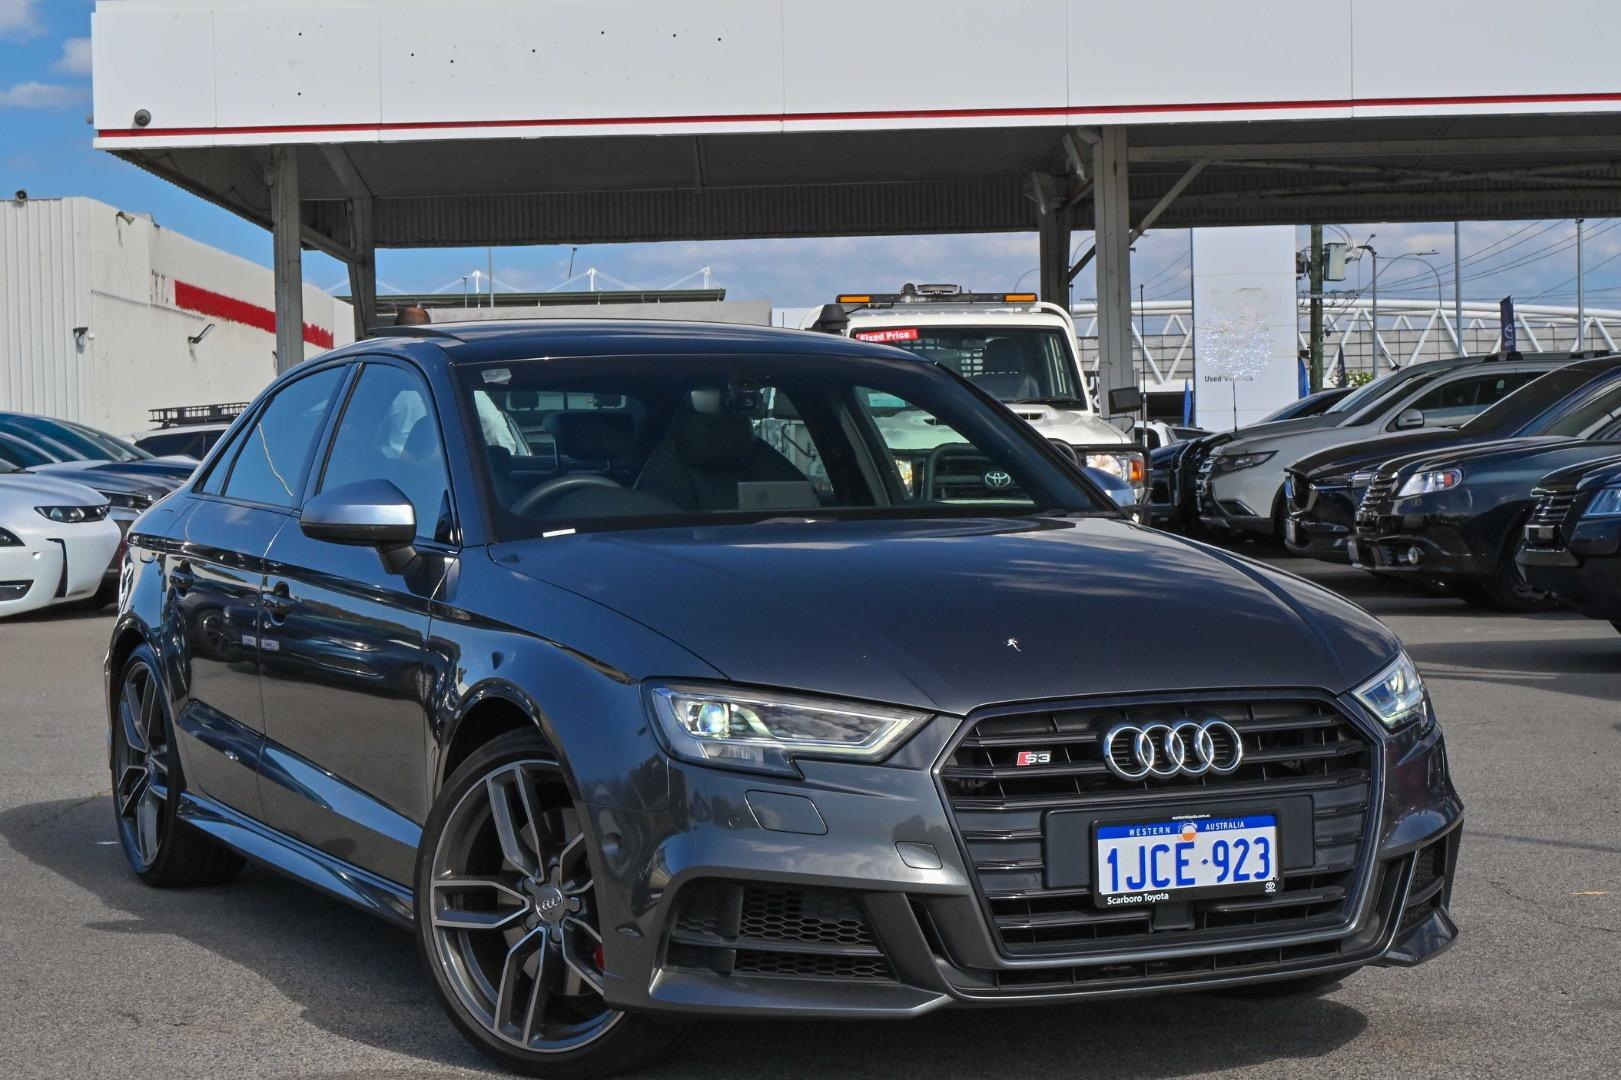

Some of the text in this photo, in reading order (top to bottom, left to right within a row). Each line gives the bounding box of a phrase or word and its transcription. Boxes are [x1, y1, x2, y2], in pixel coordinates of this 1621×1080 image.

[860, 330, 910, 342] Fixed Price
[1204, 375, 1222, 383] Used
[1025, 753, 1051, 764] S3
[1128, 821, 1245, 836] WESTERN AUSTRALIA
[1107, 892, 1169, 905] Scarboro Toyota
